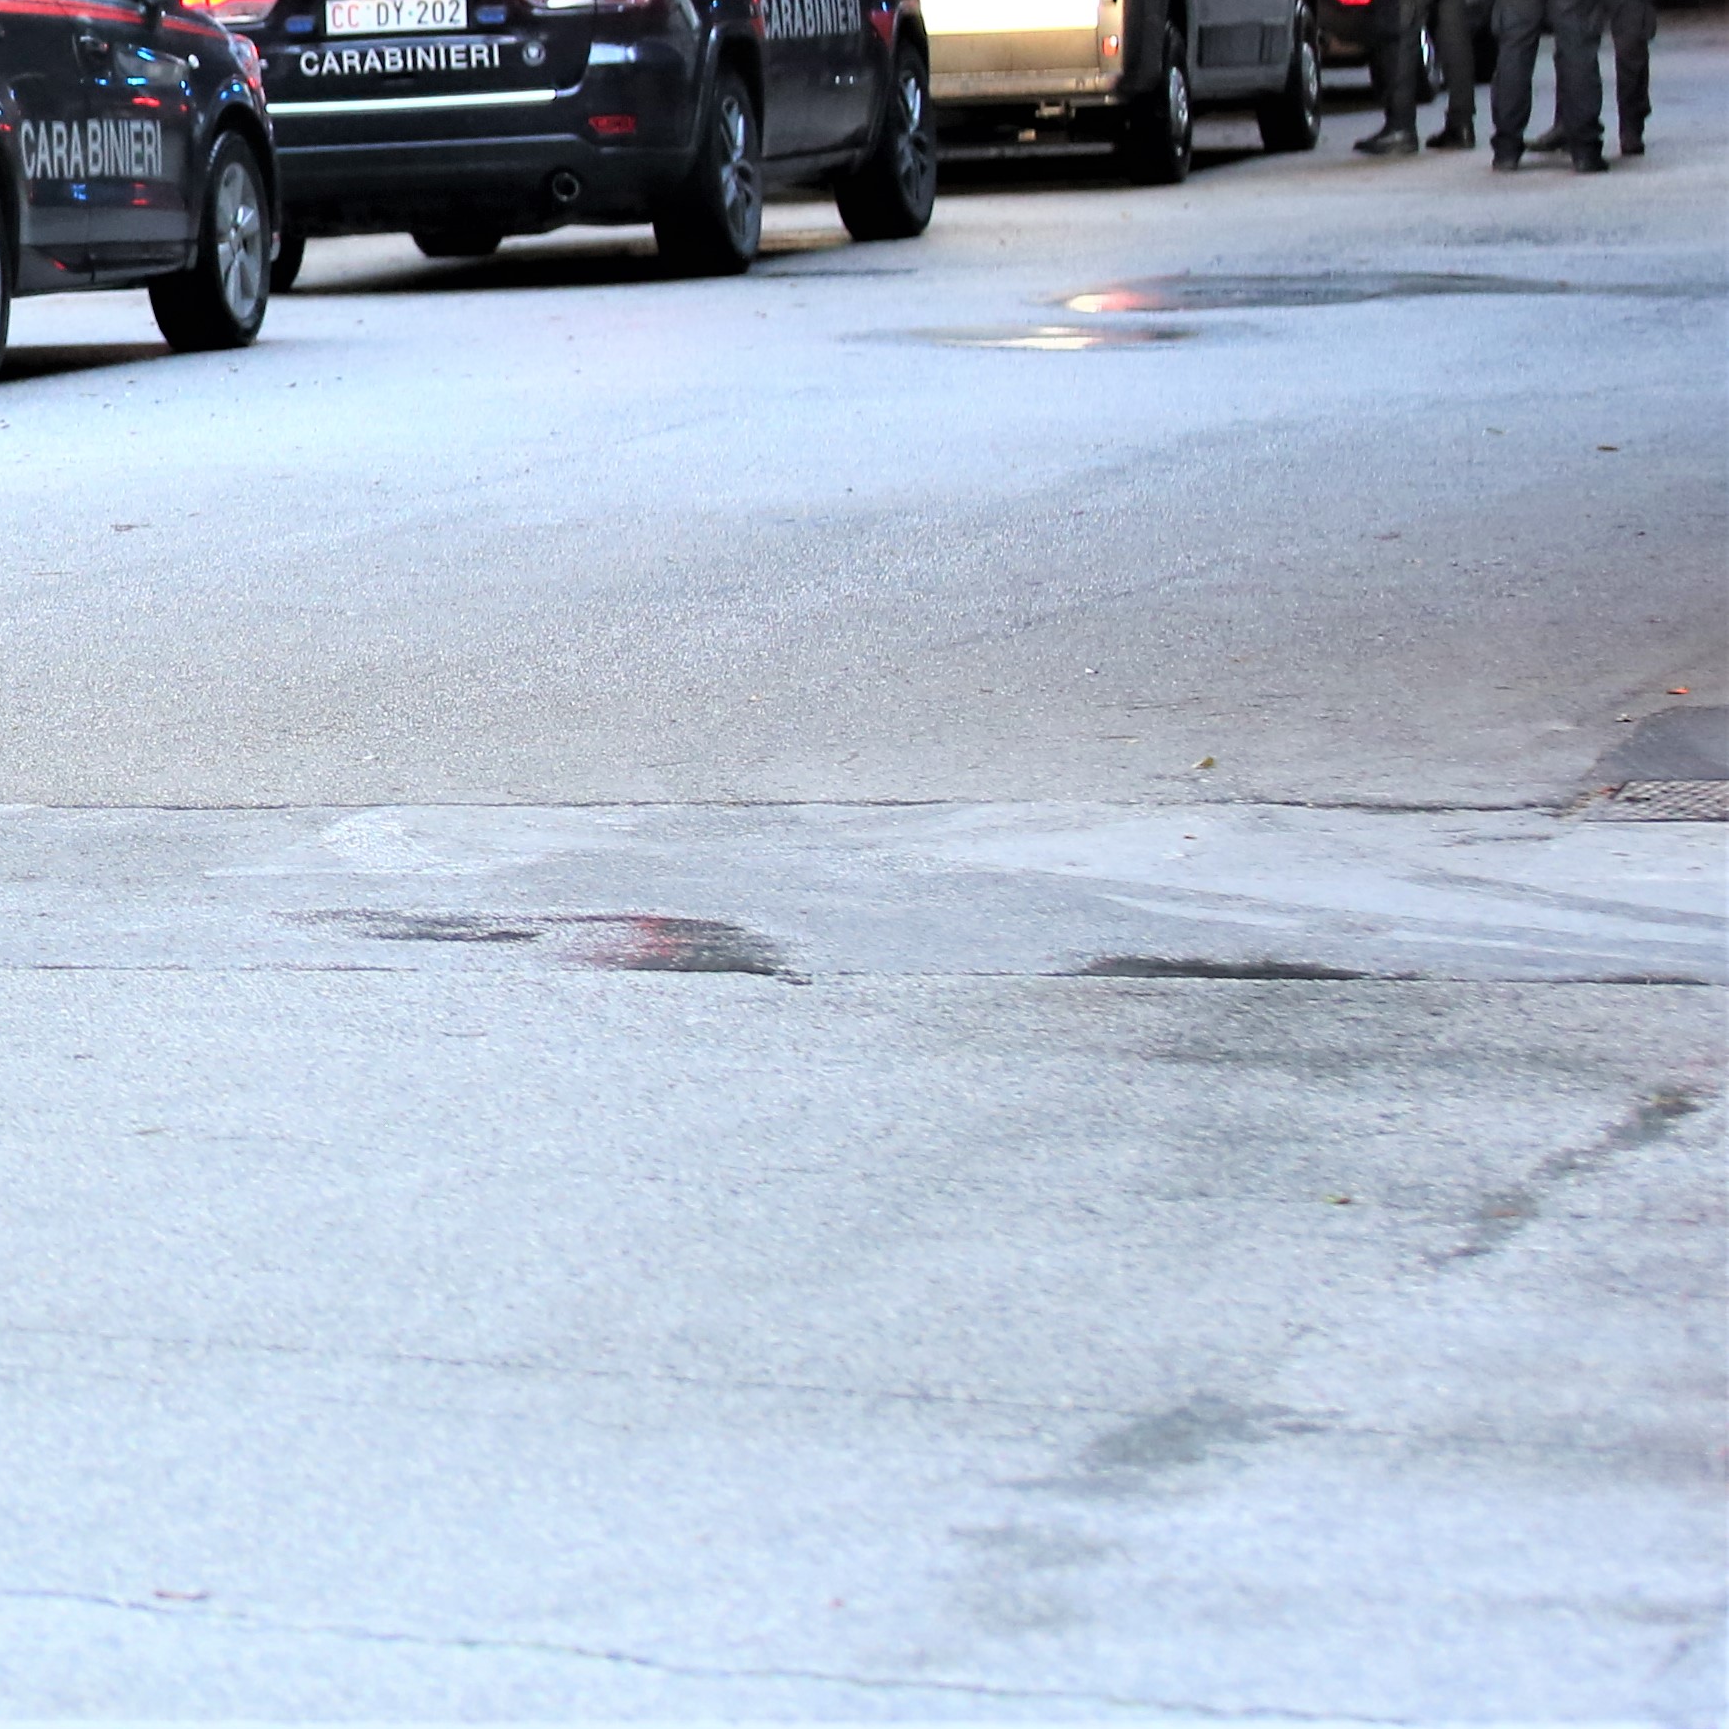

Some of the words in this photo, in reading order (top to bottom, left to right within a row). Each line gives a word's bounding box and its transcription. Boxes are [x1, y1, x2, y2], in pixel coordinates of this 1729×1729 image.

[331, 3, 360, 29] CC
[377, 0, 404, 27] DY
[300, 43, 501, 77] CARABINIERI
[20, 118, 163, 180] CARABINIERI
